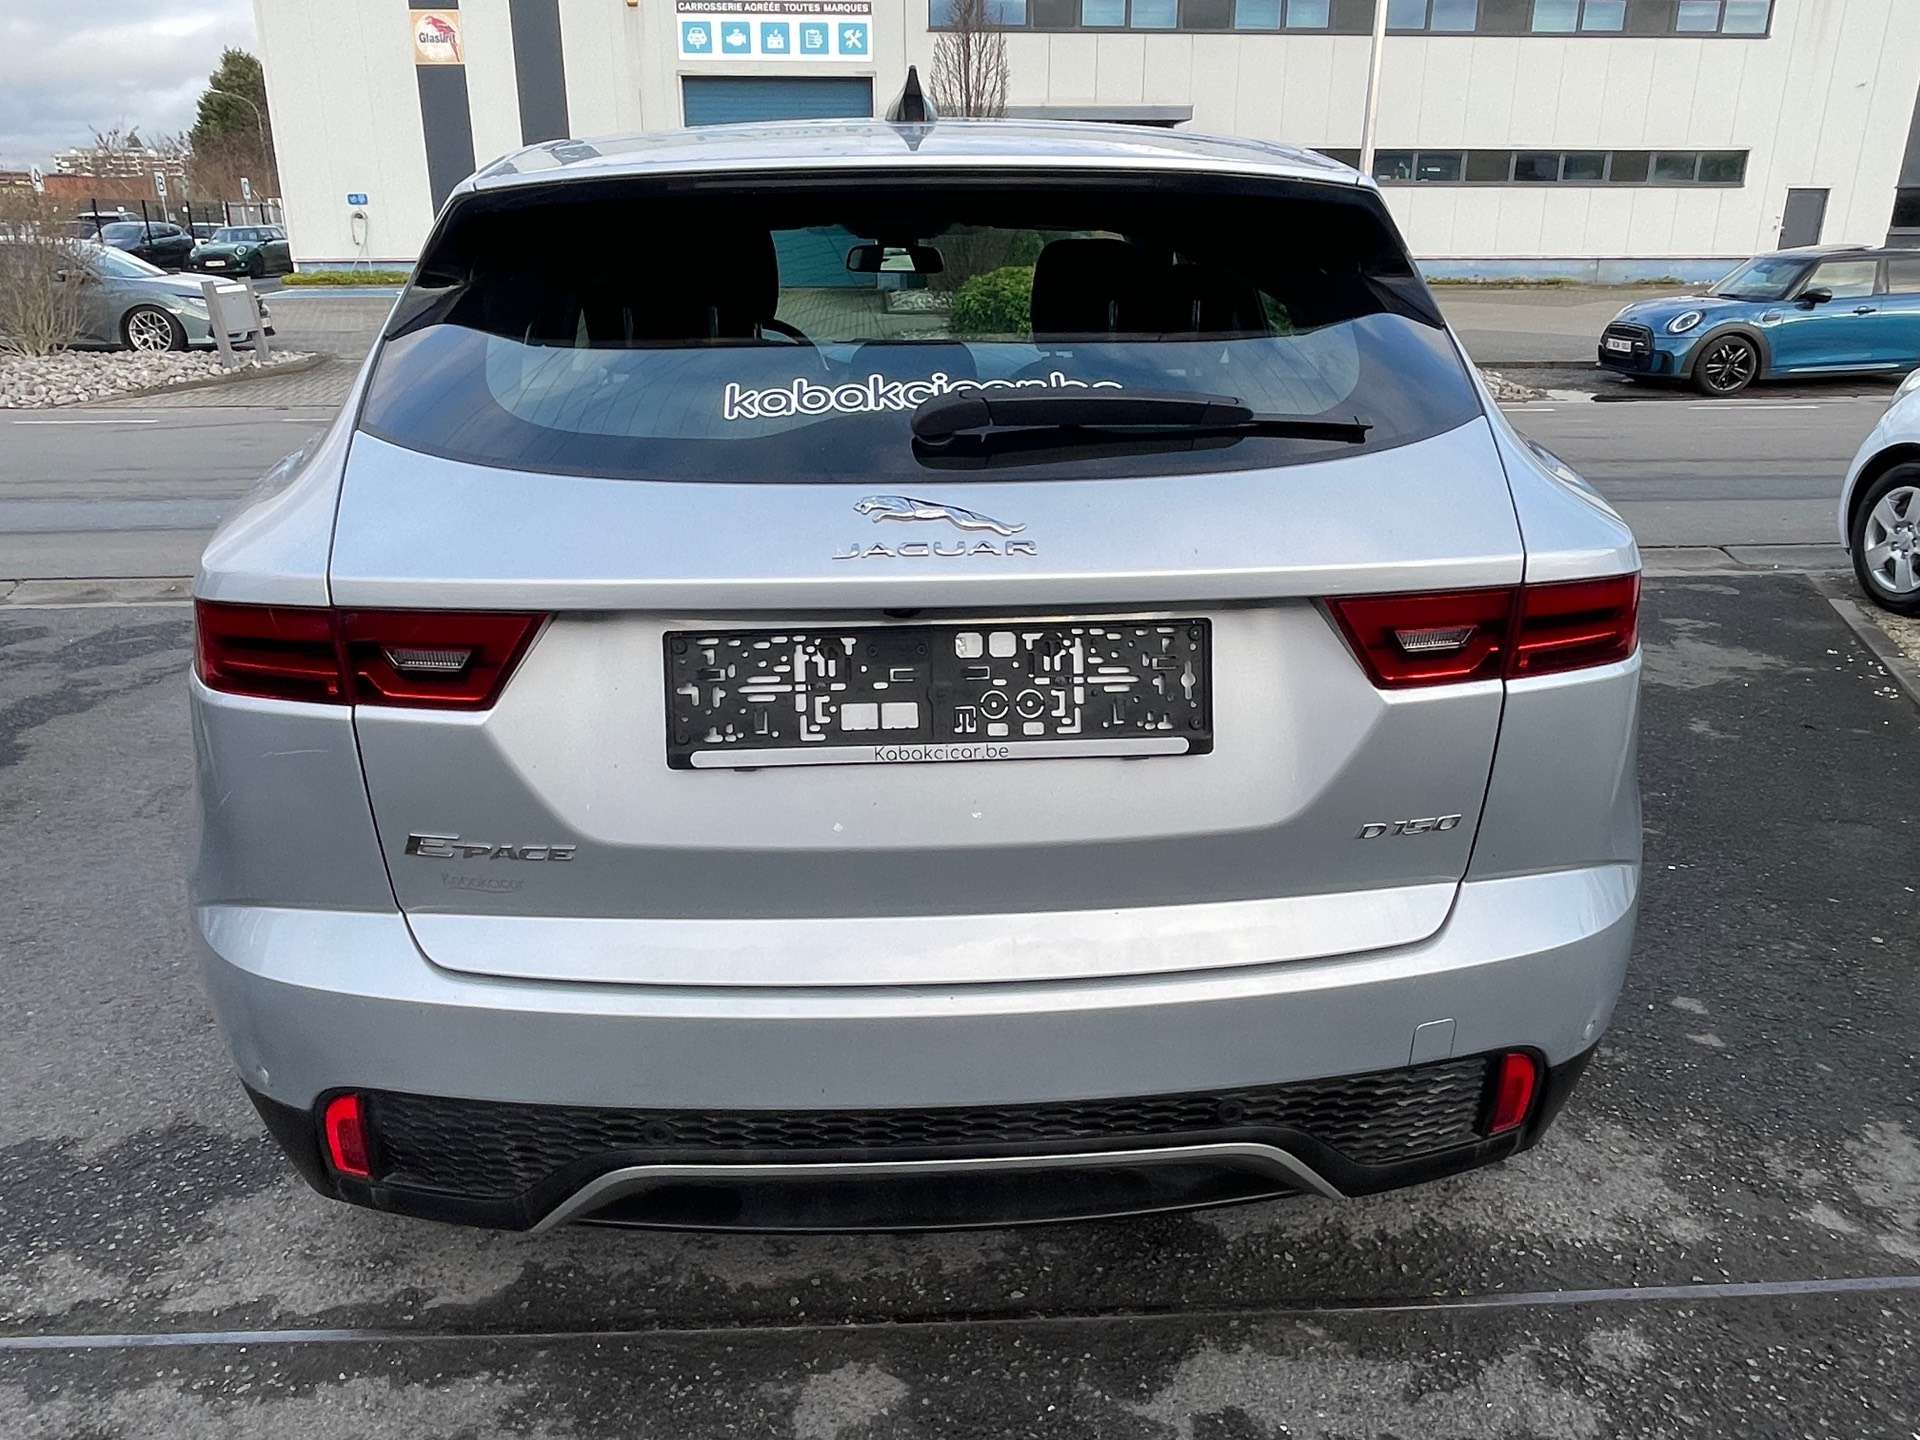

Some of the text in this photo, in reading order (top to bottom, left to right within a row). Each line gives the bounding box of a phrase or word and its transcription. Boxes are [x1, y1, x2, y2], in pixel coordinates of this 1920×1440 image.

[678, 2, 742, 11] CARROSSERIE
[783, 3, 821, 12] TOUTES
[823, 3, 869, 13] MARQUES
[156, 175, 165, 192] B
[832, 540, 1038, 560] JAGUAR
[874, 743, 1009, 761] Kabakcicar.be
